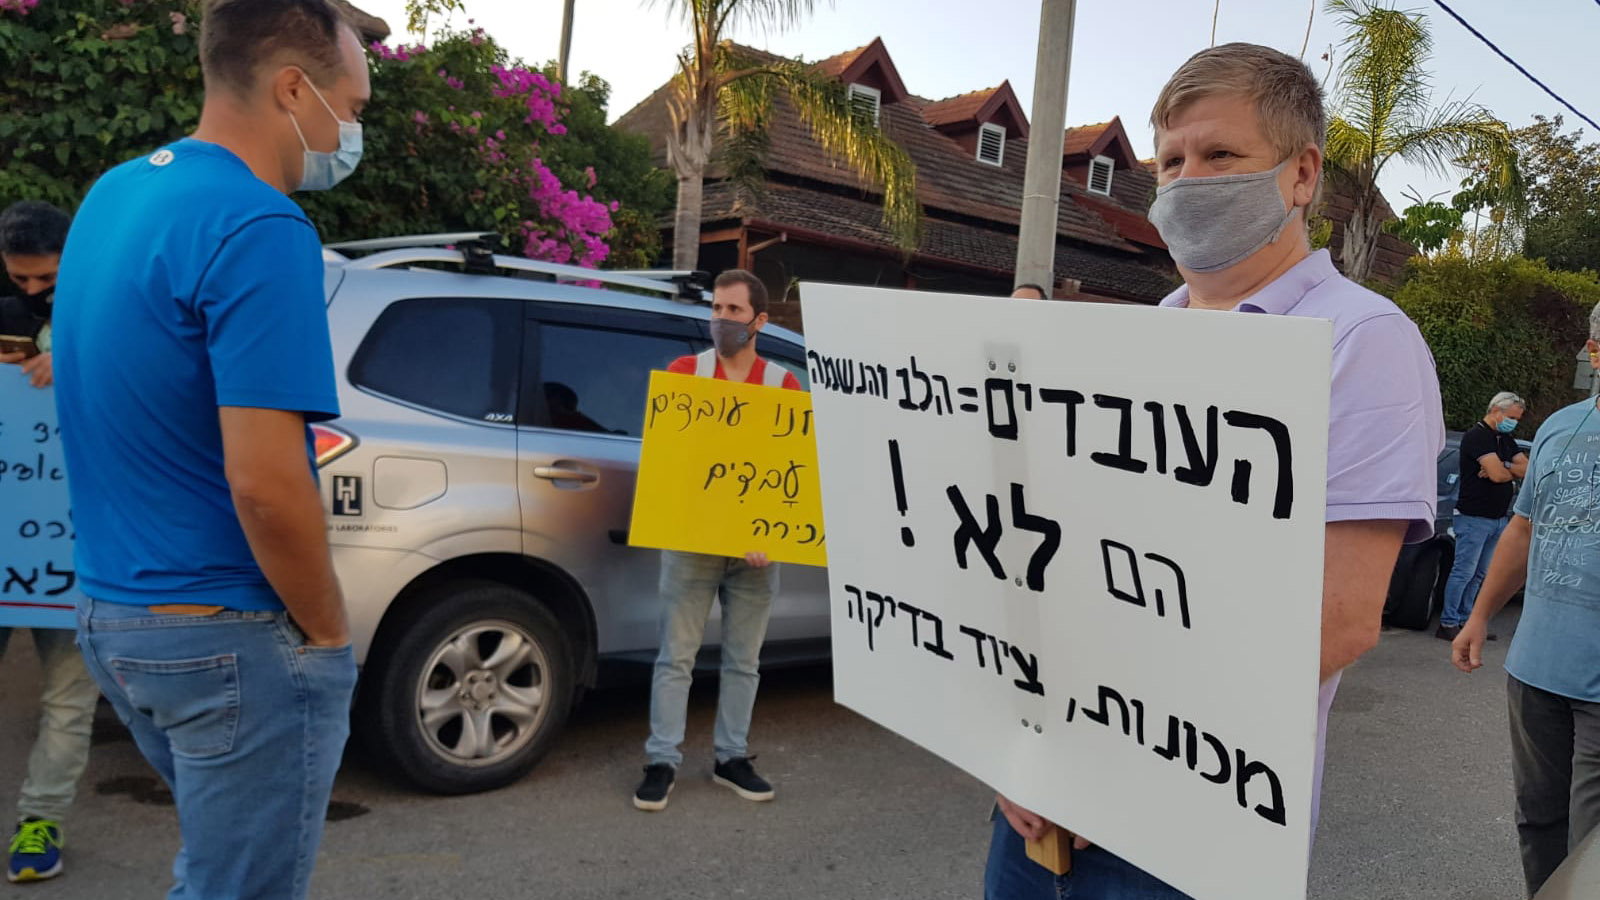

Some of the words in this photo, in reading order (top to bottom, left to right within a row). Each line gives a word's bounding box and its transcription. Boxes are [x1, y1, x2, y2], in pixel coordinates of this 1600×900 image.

[650, 391, 750, 431] עובדים
[807, 349, 888, 399] והנשמה
[945, 482, 1062, 593] לא
[1101, 539, 1191, 629] הם
[844, 585, 954, 660] בדיקה
[959, 625, 1045, 696] ציוד
[1066, 685, 1287, 826] מכונות,
